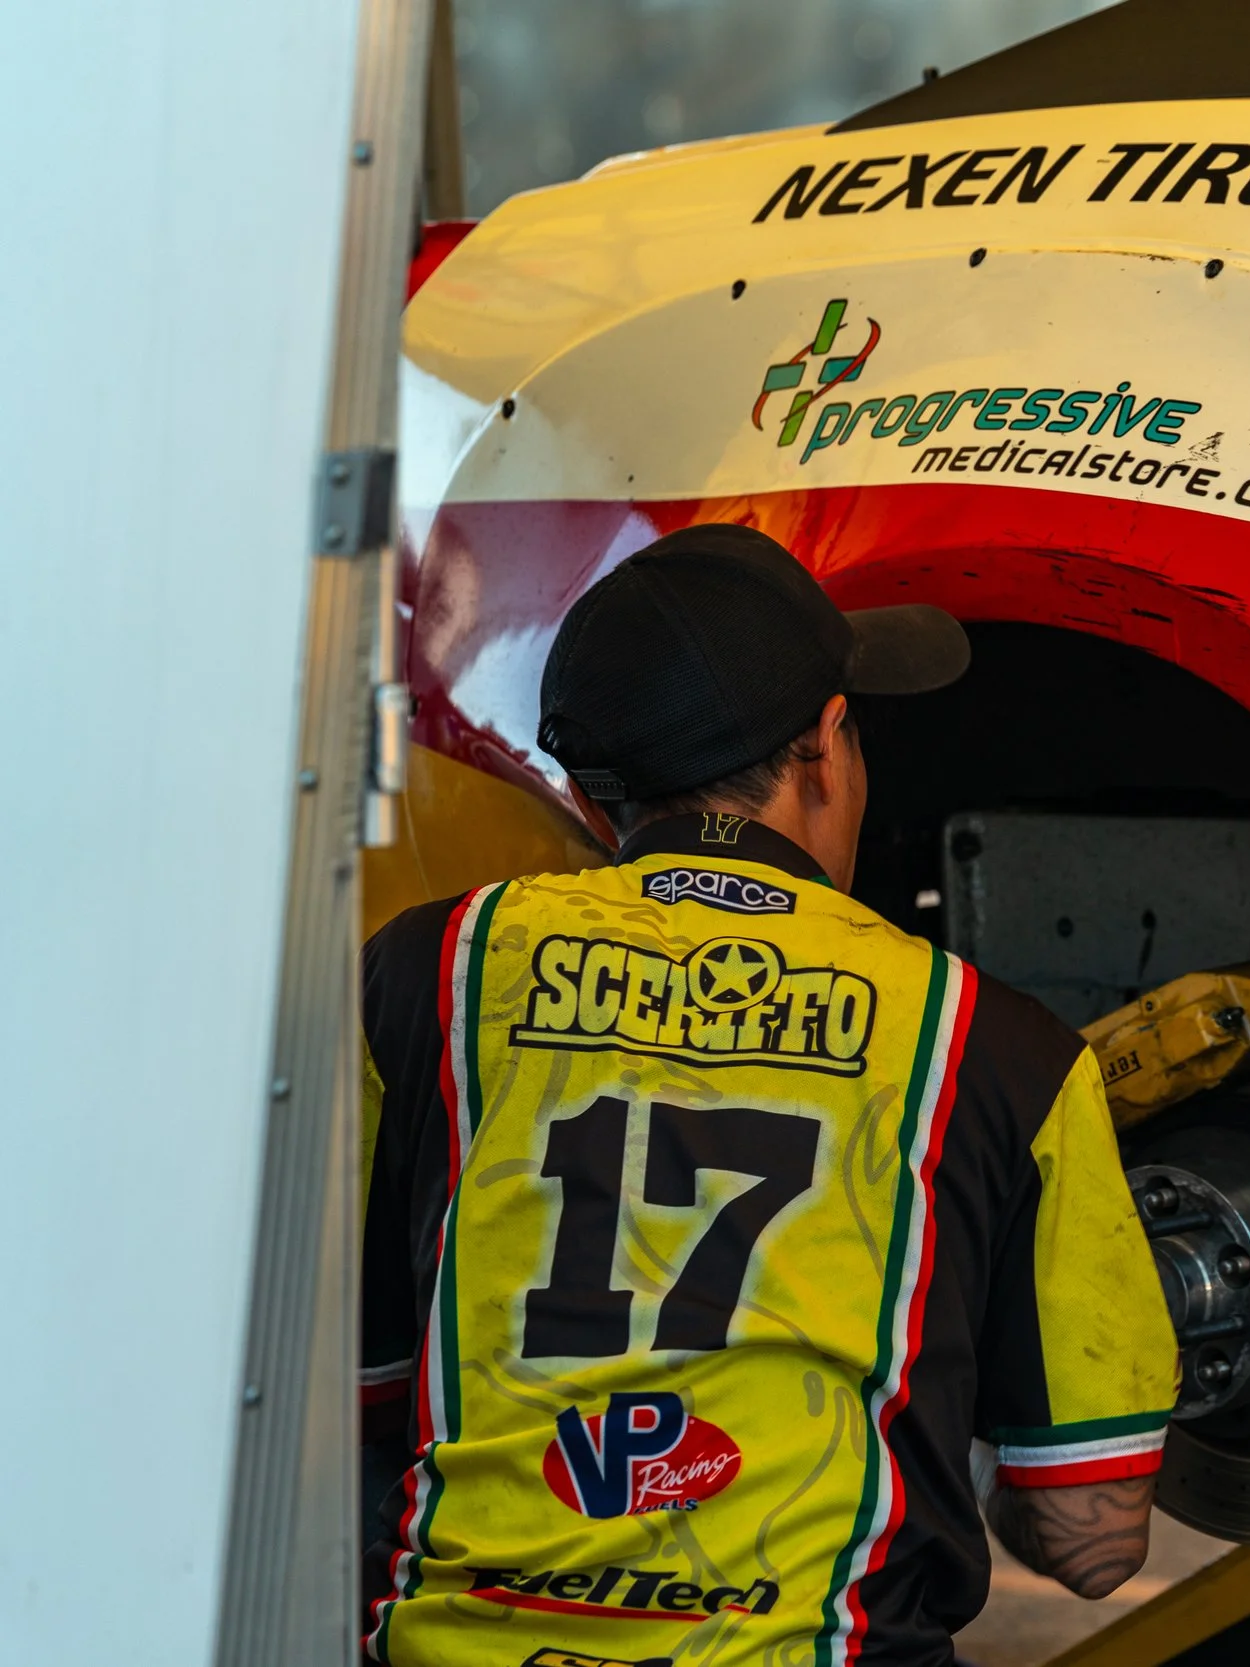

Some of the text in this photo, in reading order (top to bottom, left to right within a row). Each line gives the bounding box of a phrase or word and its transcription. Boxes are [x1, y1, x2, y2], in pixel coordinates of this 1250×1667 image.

[751, 144, 1086, 224] NEXEN
[701, 811, 750, 844] 17
[648, 870, 790, 905] sparco
[521, 1096, 821, 1358] 17
[556, 1392, 688, 1520] VP
[636, 1452, 741, 1507] Racing
[463, 1566, 780, 1616] FuelTech
